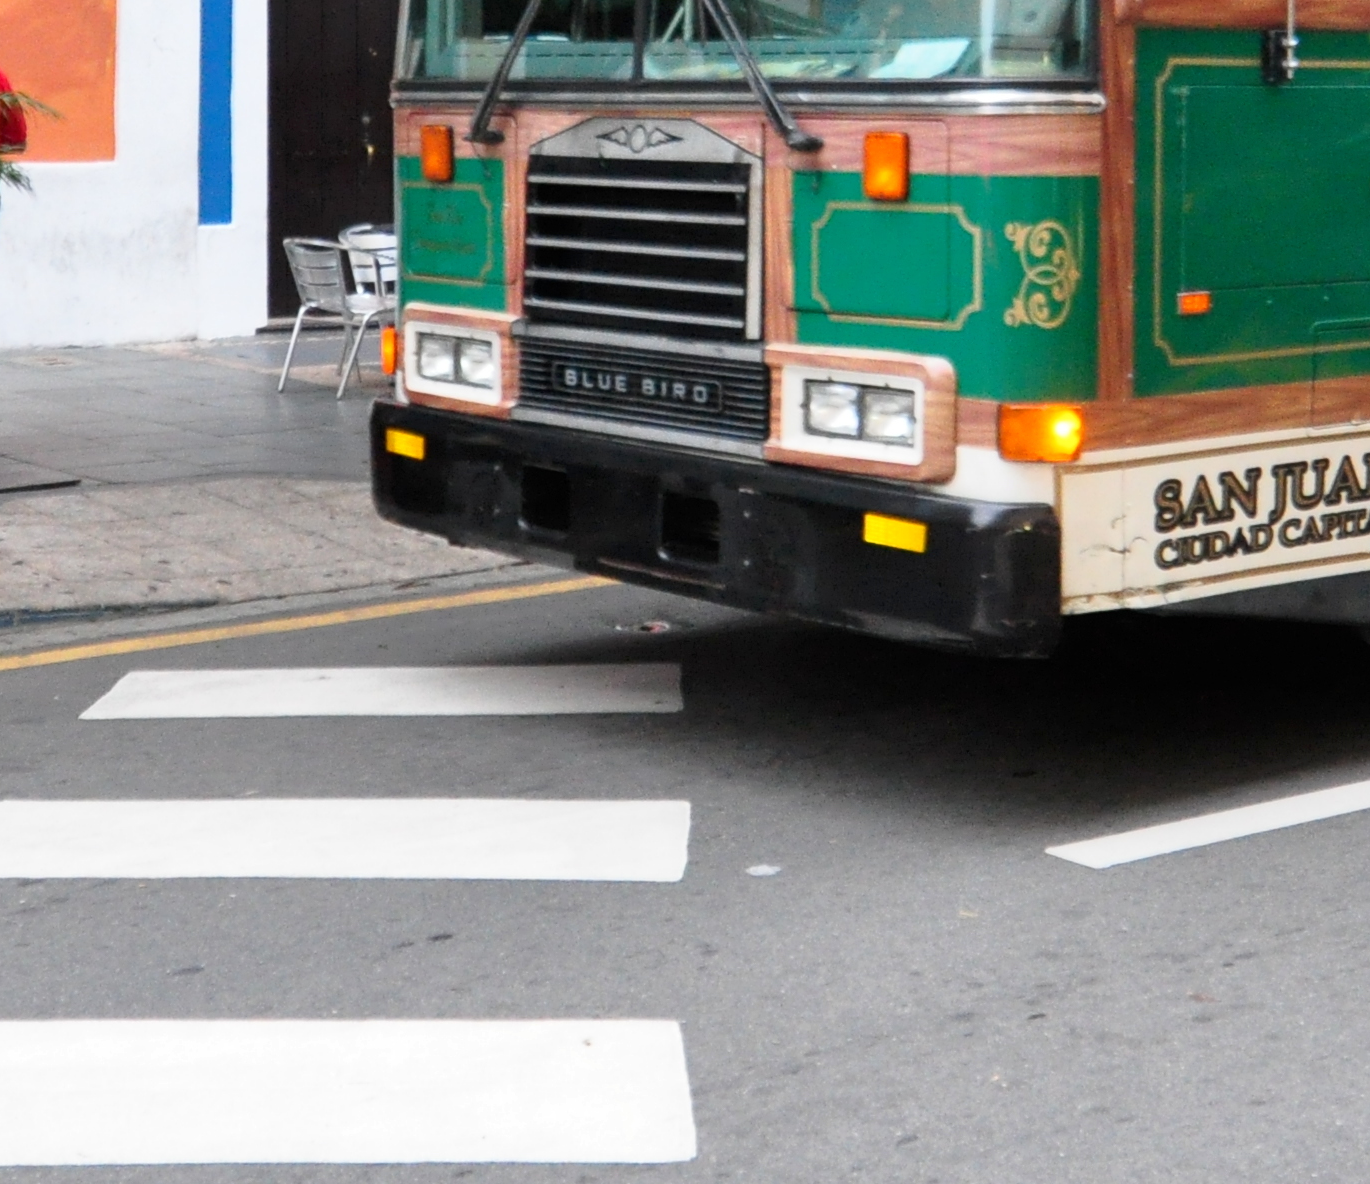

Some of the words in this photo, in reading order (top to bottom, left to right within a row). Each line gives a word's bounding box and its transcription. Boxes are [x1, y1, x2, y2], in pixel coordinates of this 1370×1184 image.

[563, 368, 628, 394] BLUE
[641, 377, 709, 404] BIRD
[1153, 466, 1262, 533] SAN
[1153, 522, 1274, 570] CIUDAD
